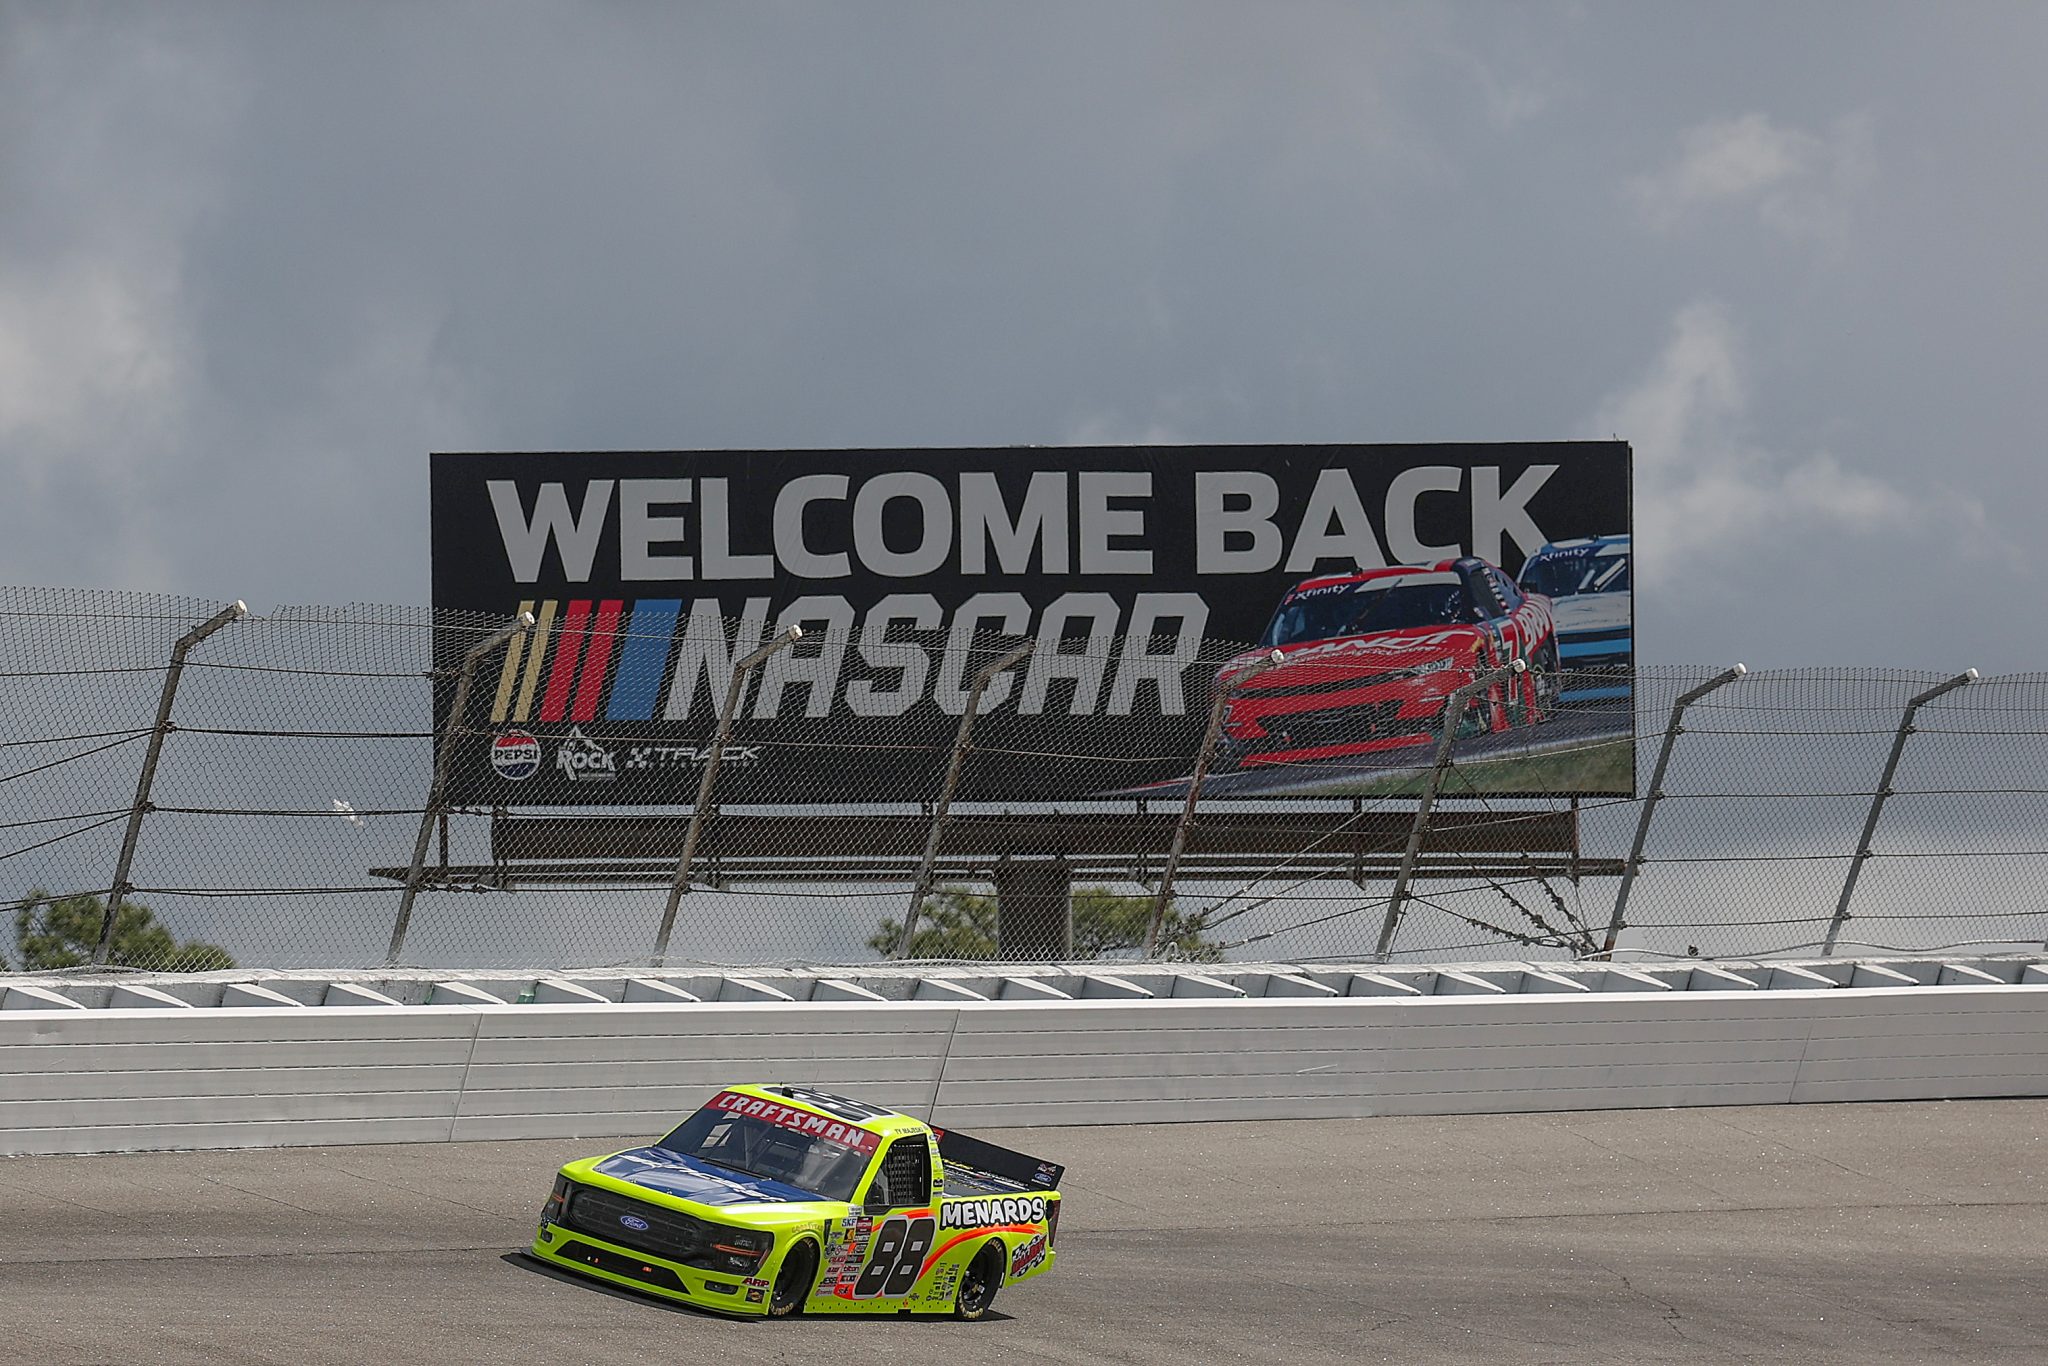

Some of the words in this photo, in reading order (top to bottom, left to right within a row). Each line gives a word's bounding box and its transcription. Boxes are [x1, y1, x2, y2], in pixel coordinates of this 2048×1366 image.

[486, 471, 1153, 583] WELCOME
[1195, 464, 1560, 575] BACK
[662, 592, 1209, 721] NASCAR
[492, 751, 538, 763] PEPSI
[717, 1094, 865, 1147] CRAFTSMAN
[622, 1216, 646, 1230] Ford
[842, 1218, 857, 1227] SKF
[941, 1197, 1045, 1229] MENARDS
[854, 1216, 936, 1298] 88
[742, 1277, 770, 1287] ARP
